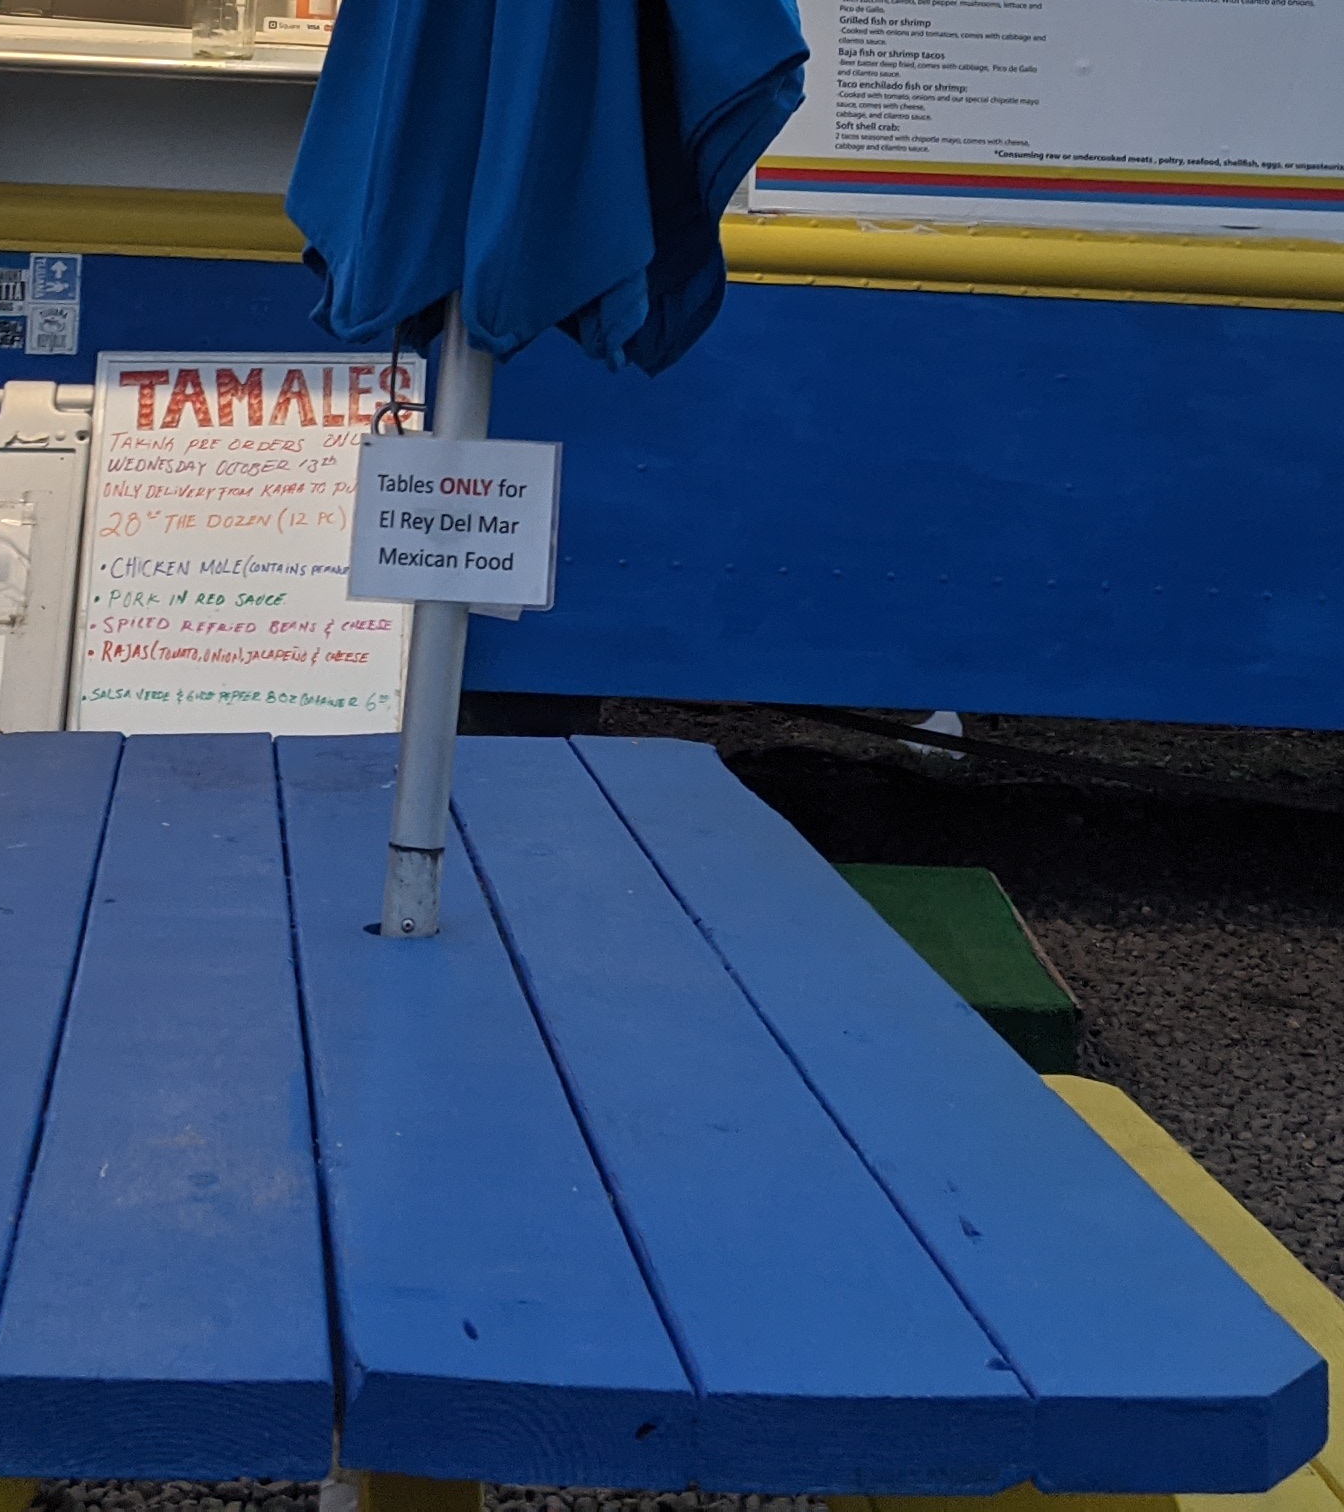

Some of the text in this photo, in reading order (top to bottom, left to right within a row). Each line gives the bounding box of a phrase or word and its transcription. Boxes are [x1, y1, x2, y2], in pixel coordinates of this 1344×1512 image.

[120, 365, 414, 430] TAMALES
[188, 438, 218, 454] PRE
[229, 439, 305, 452] ORDERS
[107, 457, 207, 475] WEDNESDAY
[216, 459, 290, 477] OCTOBER
[103, 482, 139, 498] ONLY
[146, 484, 214, 501] DELIVERY
[378, 474, 527, 498] Tables ONLY for
[164, 514, 196, 534] THE
[206, 514, 271, 529] DOZEN
[277, 507, 308, 534] (12
[379, 510, 519, 534] El Rey Del Mar
[110, 556, 190, 580] CHICKEN
[379, 547, 514, 571] Mexican Food
[109, 590, 160, 608] PORK
[170, 589, 185, 605] IN
[196, 591, 226, 606] RED
[269, 621, 316, 634] BEANS
